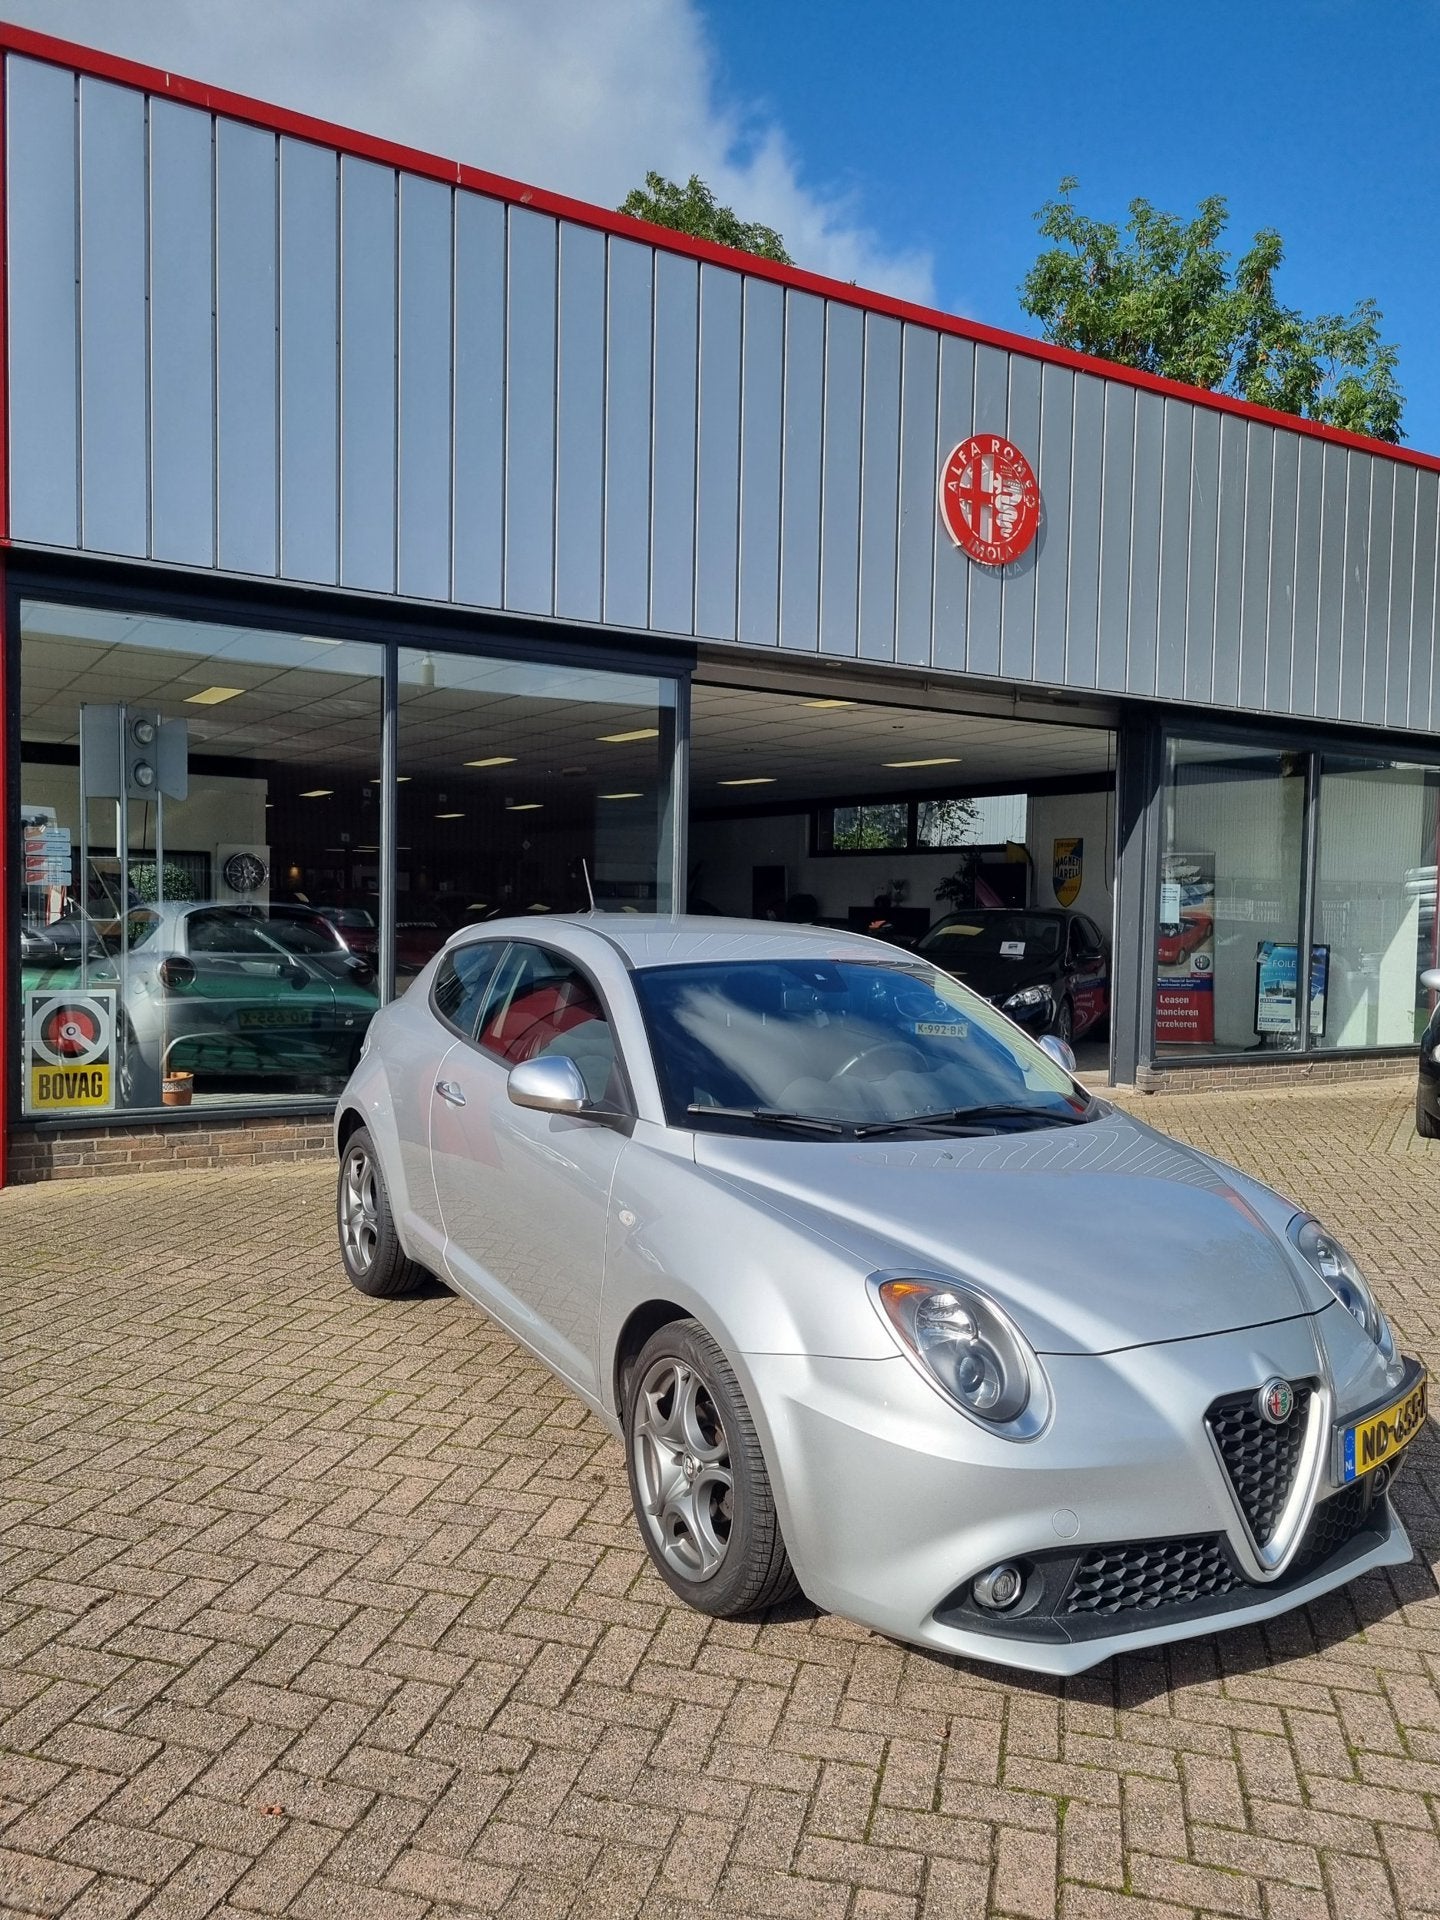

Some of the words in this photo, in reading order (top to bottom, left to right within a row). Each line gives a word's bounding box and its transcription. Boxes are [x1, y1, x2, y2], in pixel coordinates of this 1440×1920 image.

[947, 441, 982, 494] ALFA
[991, 439, 1036, 509] ROMEO
[967, 537, 1015, 561] IMOLA
[1159, 994, 1189, 1004] Leasen
[1156, 1007, 1199, 1016] inancieren
[917, 1023, 964, 1036] K-992-BR
[1155, 1019, 1198, 1028] erzekeren
[37, 1070, 103, 1101] BOVAG
[1345, 1459, 1354, 1472] NL
